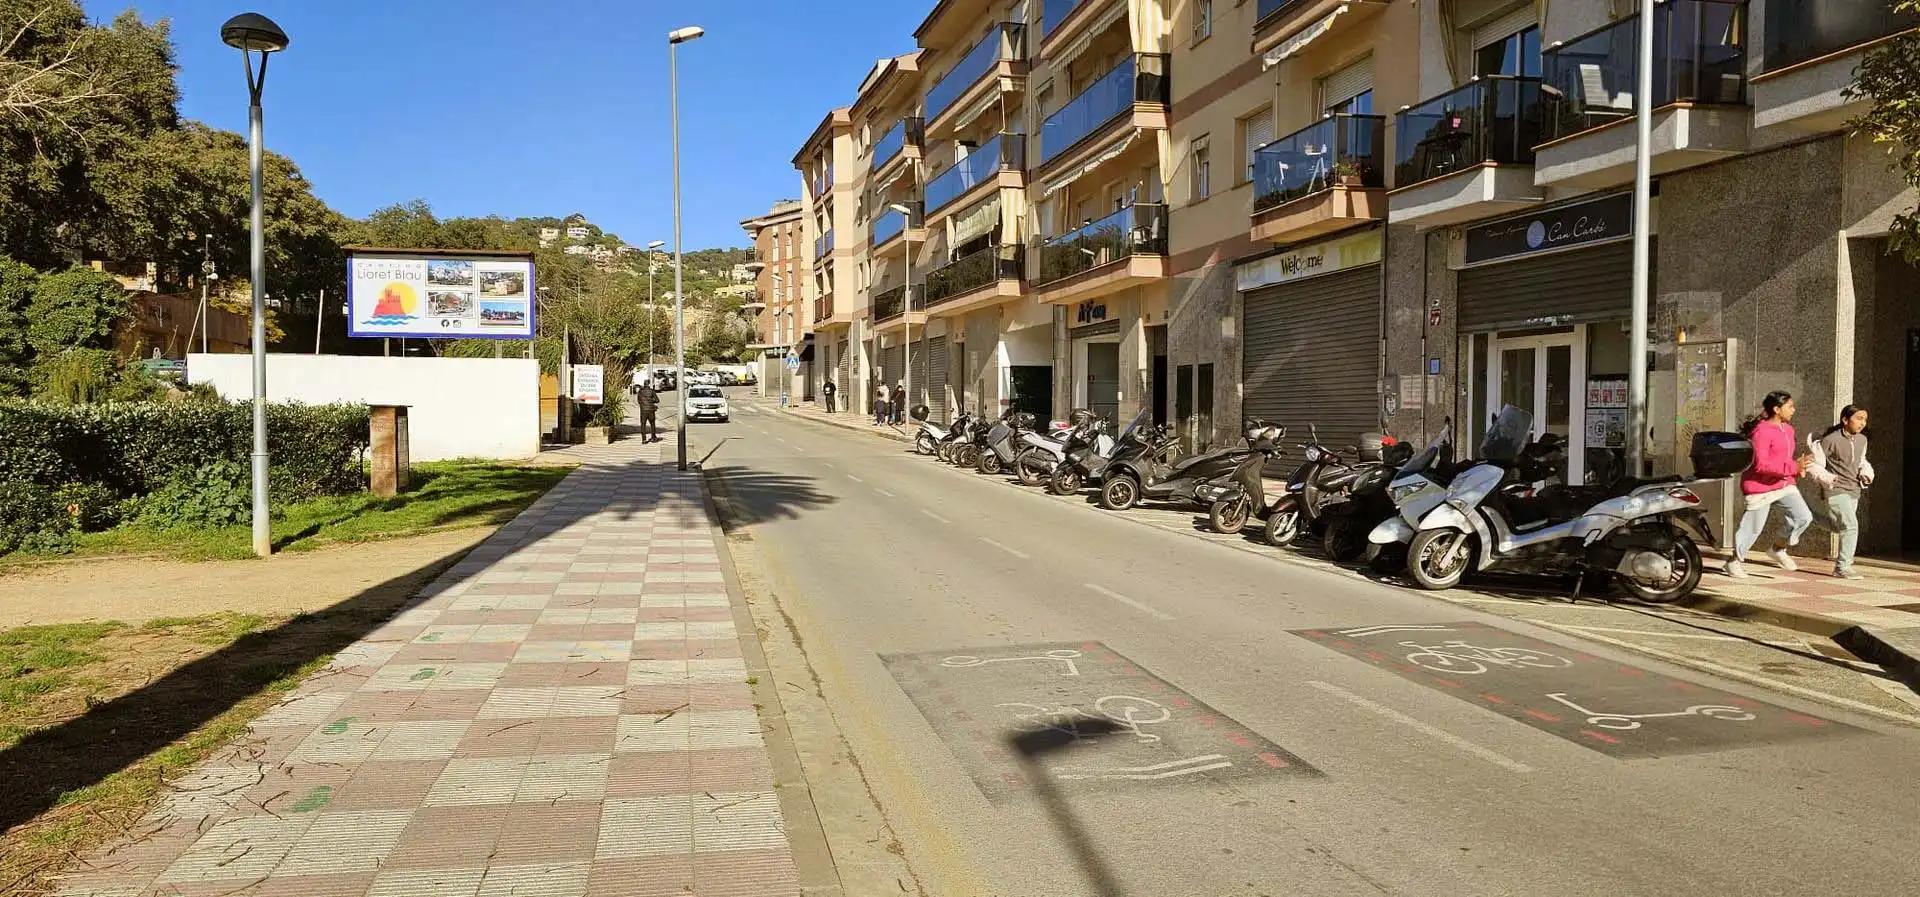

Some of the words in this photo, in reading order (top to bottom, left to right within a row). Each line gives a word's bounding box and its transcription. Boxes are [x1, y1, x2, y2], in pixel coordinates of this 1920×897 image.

[1281, 255, 1324, 275] Welcome
[357, 268, 392, 280] Lloret
[394, 269, 422, 281] Blau
